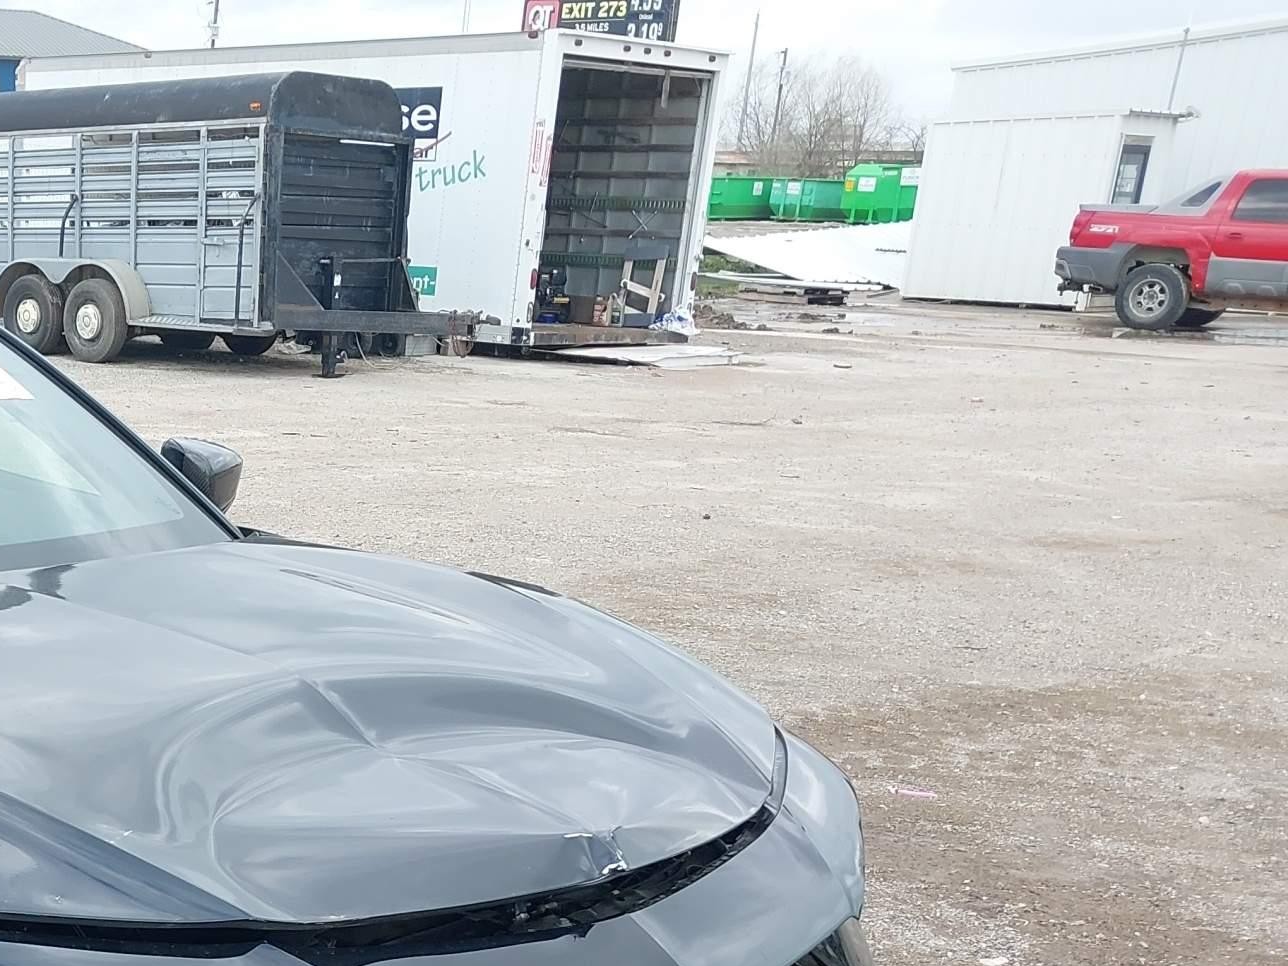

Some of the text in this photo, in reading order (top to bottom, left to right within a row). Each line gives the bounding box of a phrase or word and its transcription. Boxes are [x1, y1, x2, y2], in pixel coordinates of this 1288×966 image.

[528, 5, 555, 31] QT
[561, 1, 628, 19] EXIT 273
[587, 22, 609, 32] MILES
[415, 149, 486, 192] truck
